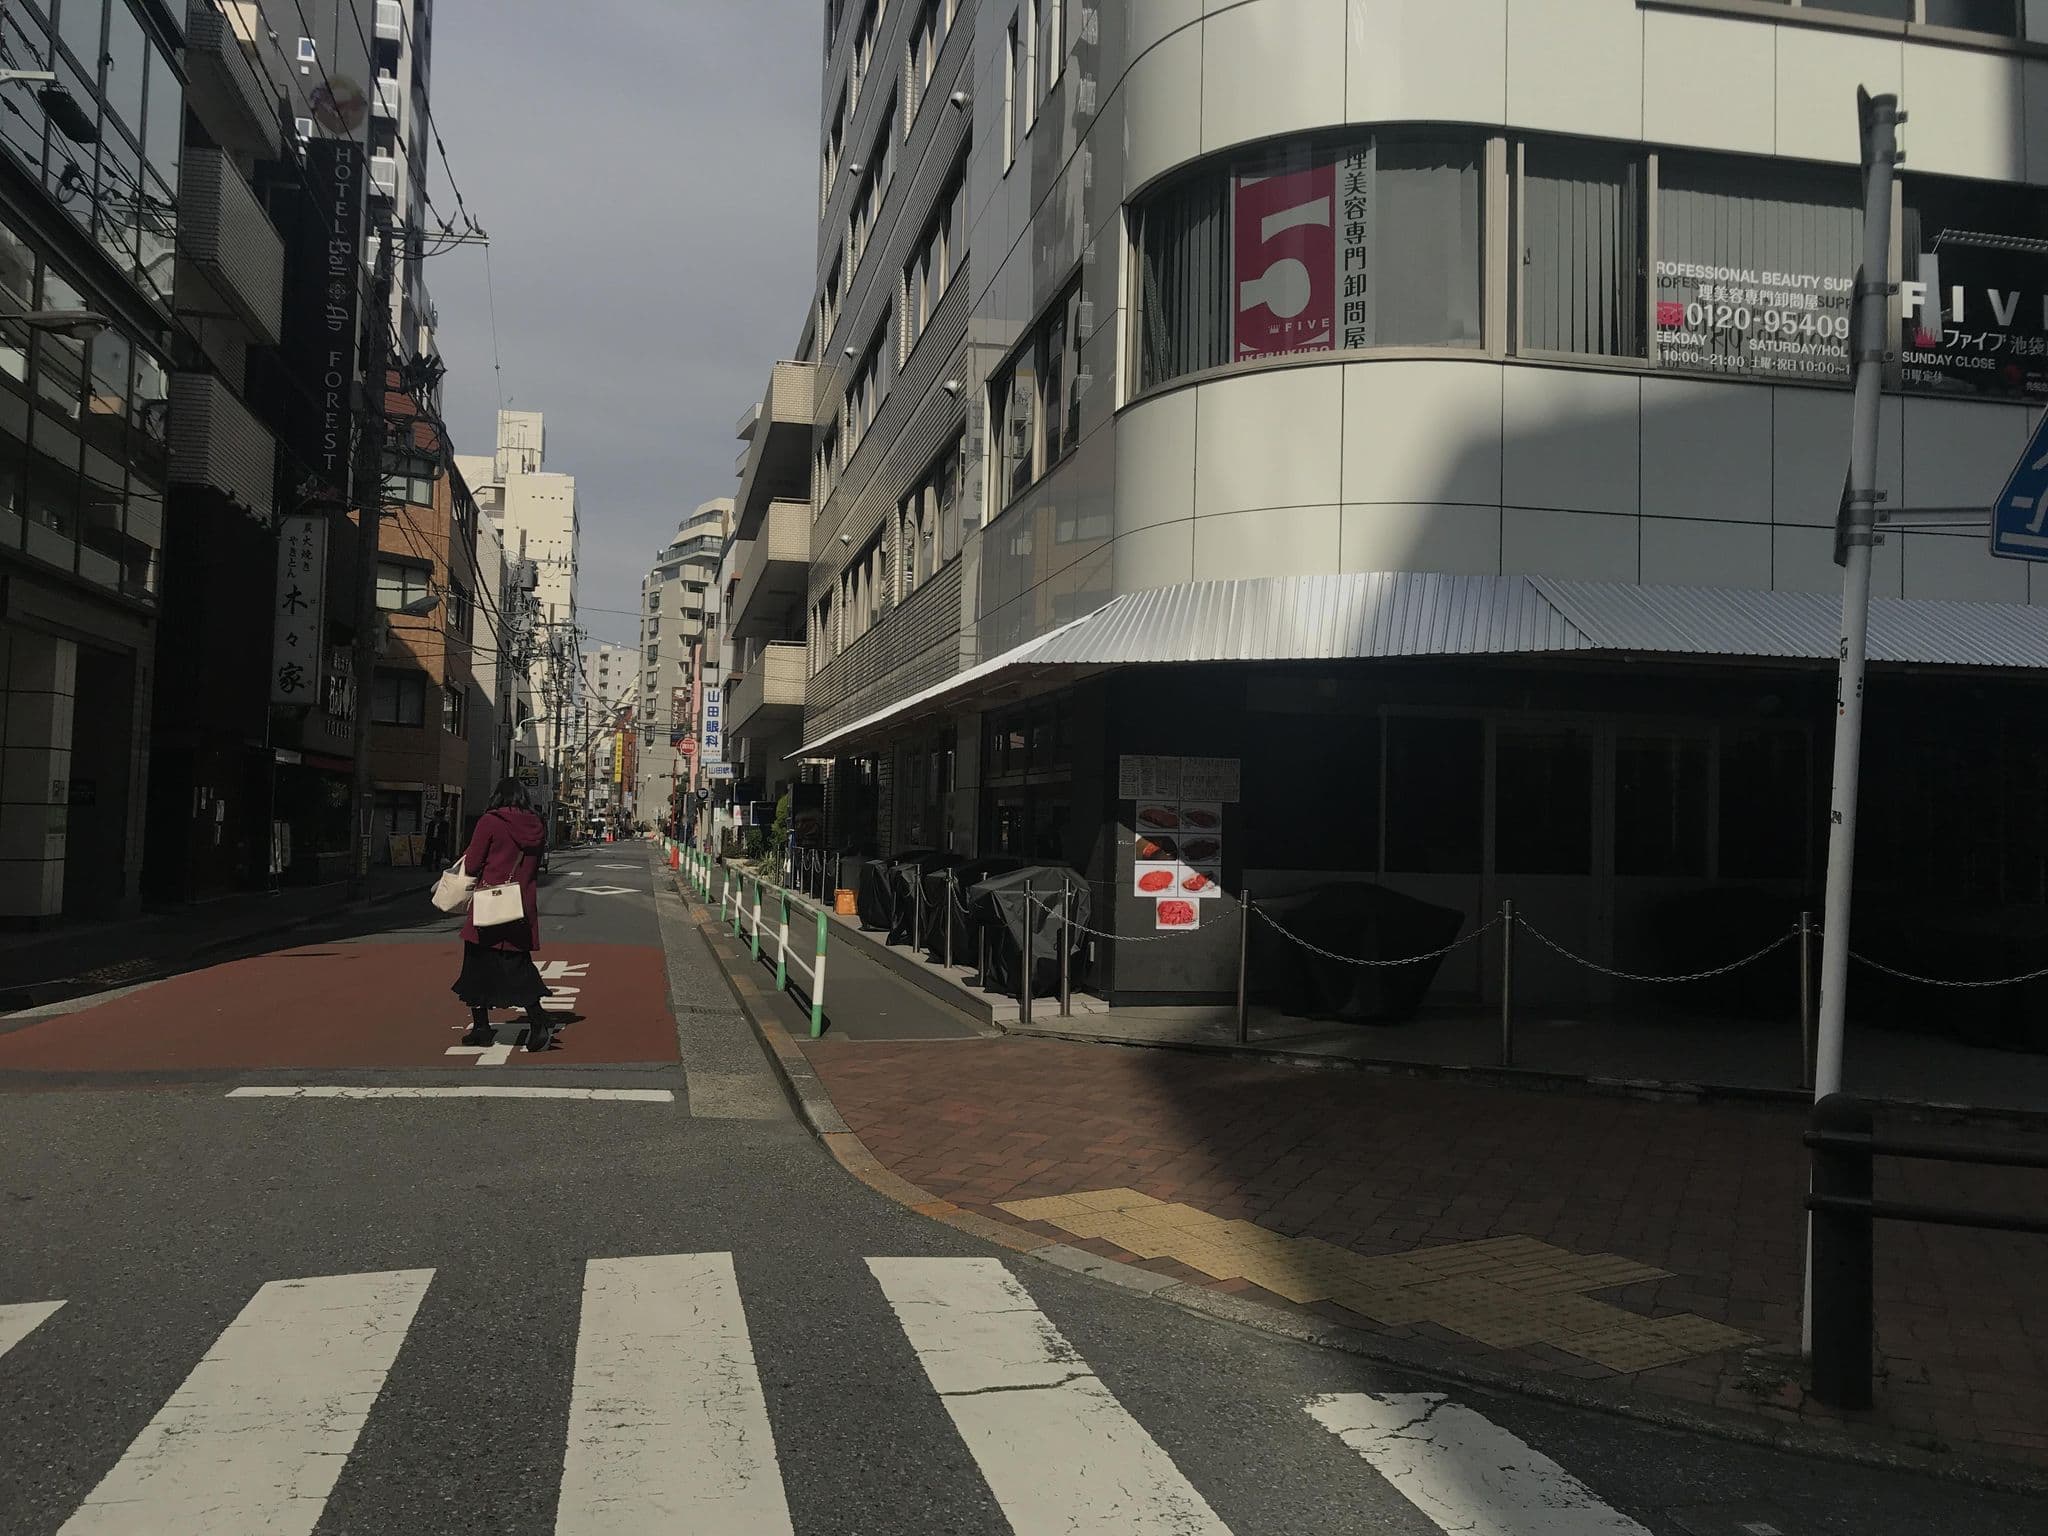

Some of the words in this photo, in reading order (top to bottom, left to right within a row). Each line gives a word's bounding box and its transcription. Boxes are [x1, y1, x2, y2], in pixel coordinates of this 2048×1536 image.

[335, 148, 352, 234] HOTEL
[1762, 272, 1820, 289] BEAUTY
[1902, 281, 2048, 331] FIV
[1285, 318, 1330, 332] FIVE
[1902, 351, 1953, 366] SUNDAY
[1955, 356, 1996, 369] CLOSE
[323, 351, 343, 471] FOREST
[279, 585, 308, 693] 木々家
[705, 691, 720, 748] 山田眼科
